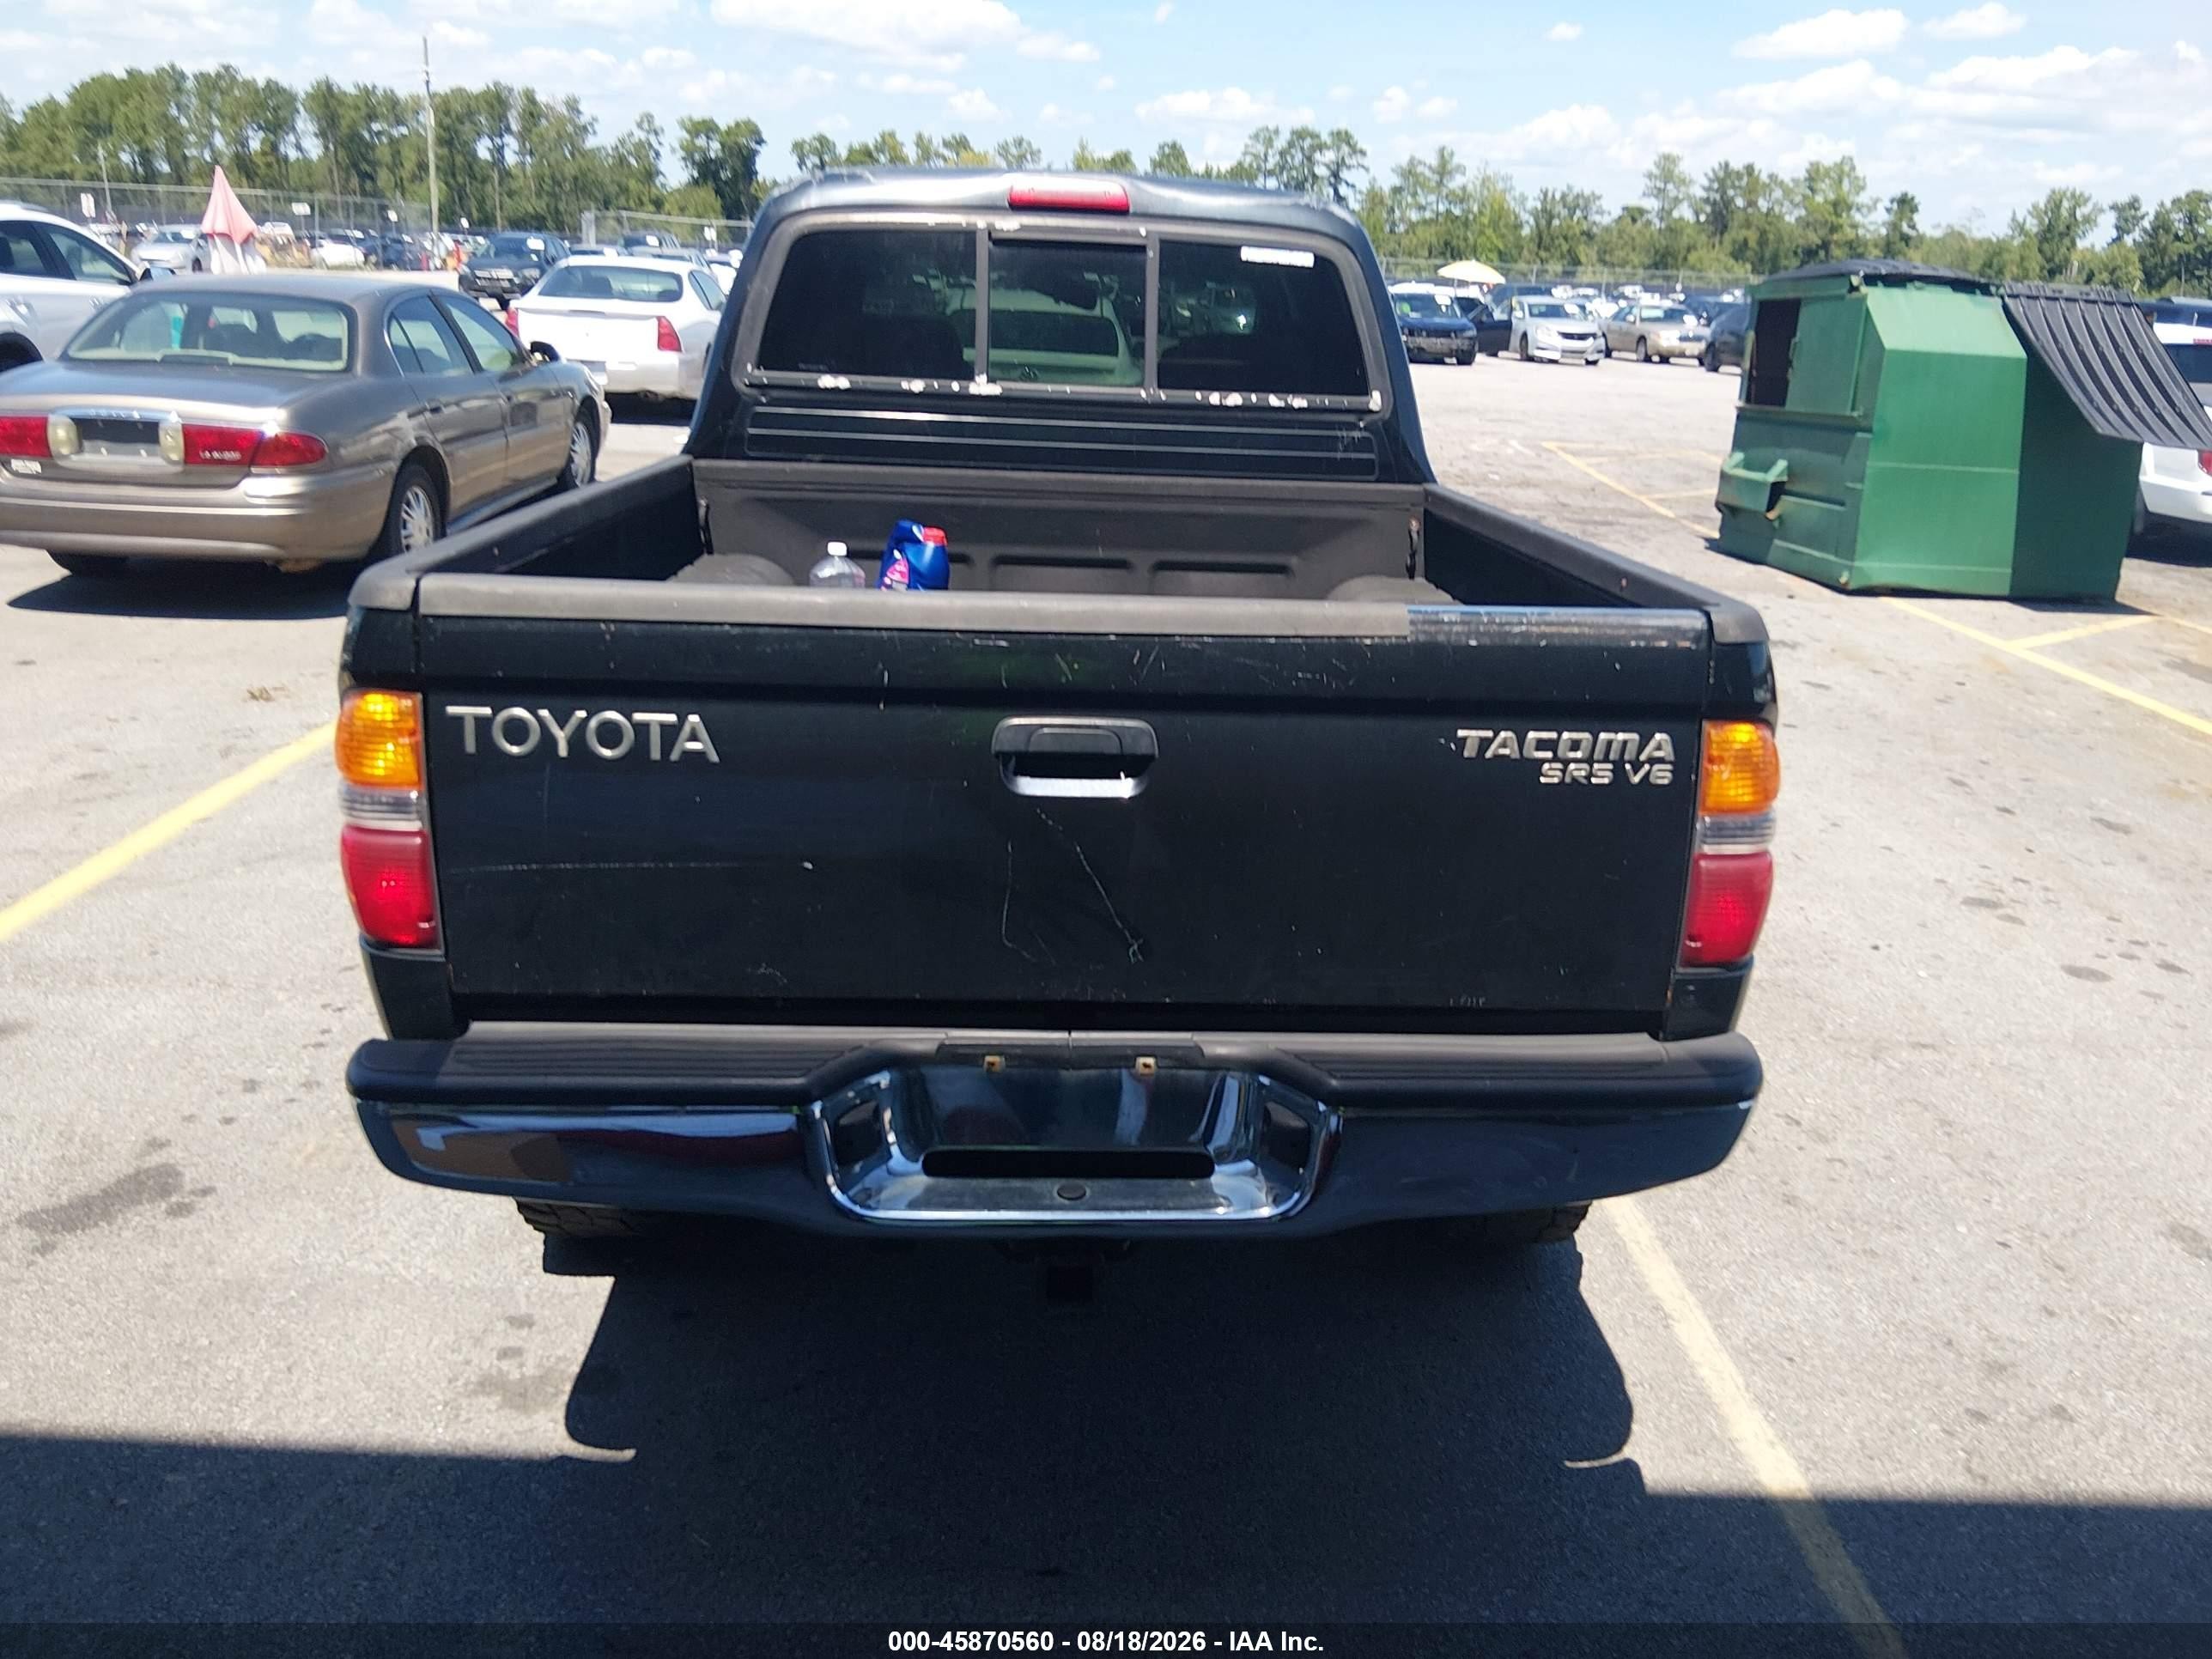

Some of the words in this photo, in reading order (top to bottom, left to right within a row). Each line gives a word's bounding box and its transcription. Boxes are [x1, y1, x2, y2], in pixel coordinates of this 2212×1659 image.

[446, 705, 720, 763] TOYOTA
[1457, 728, 1675, 762] TACOMA
[1539, 762, 1614, 785] SR5
[1624, 763, 1674, 785] V6
